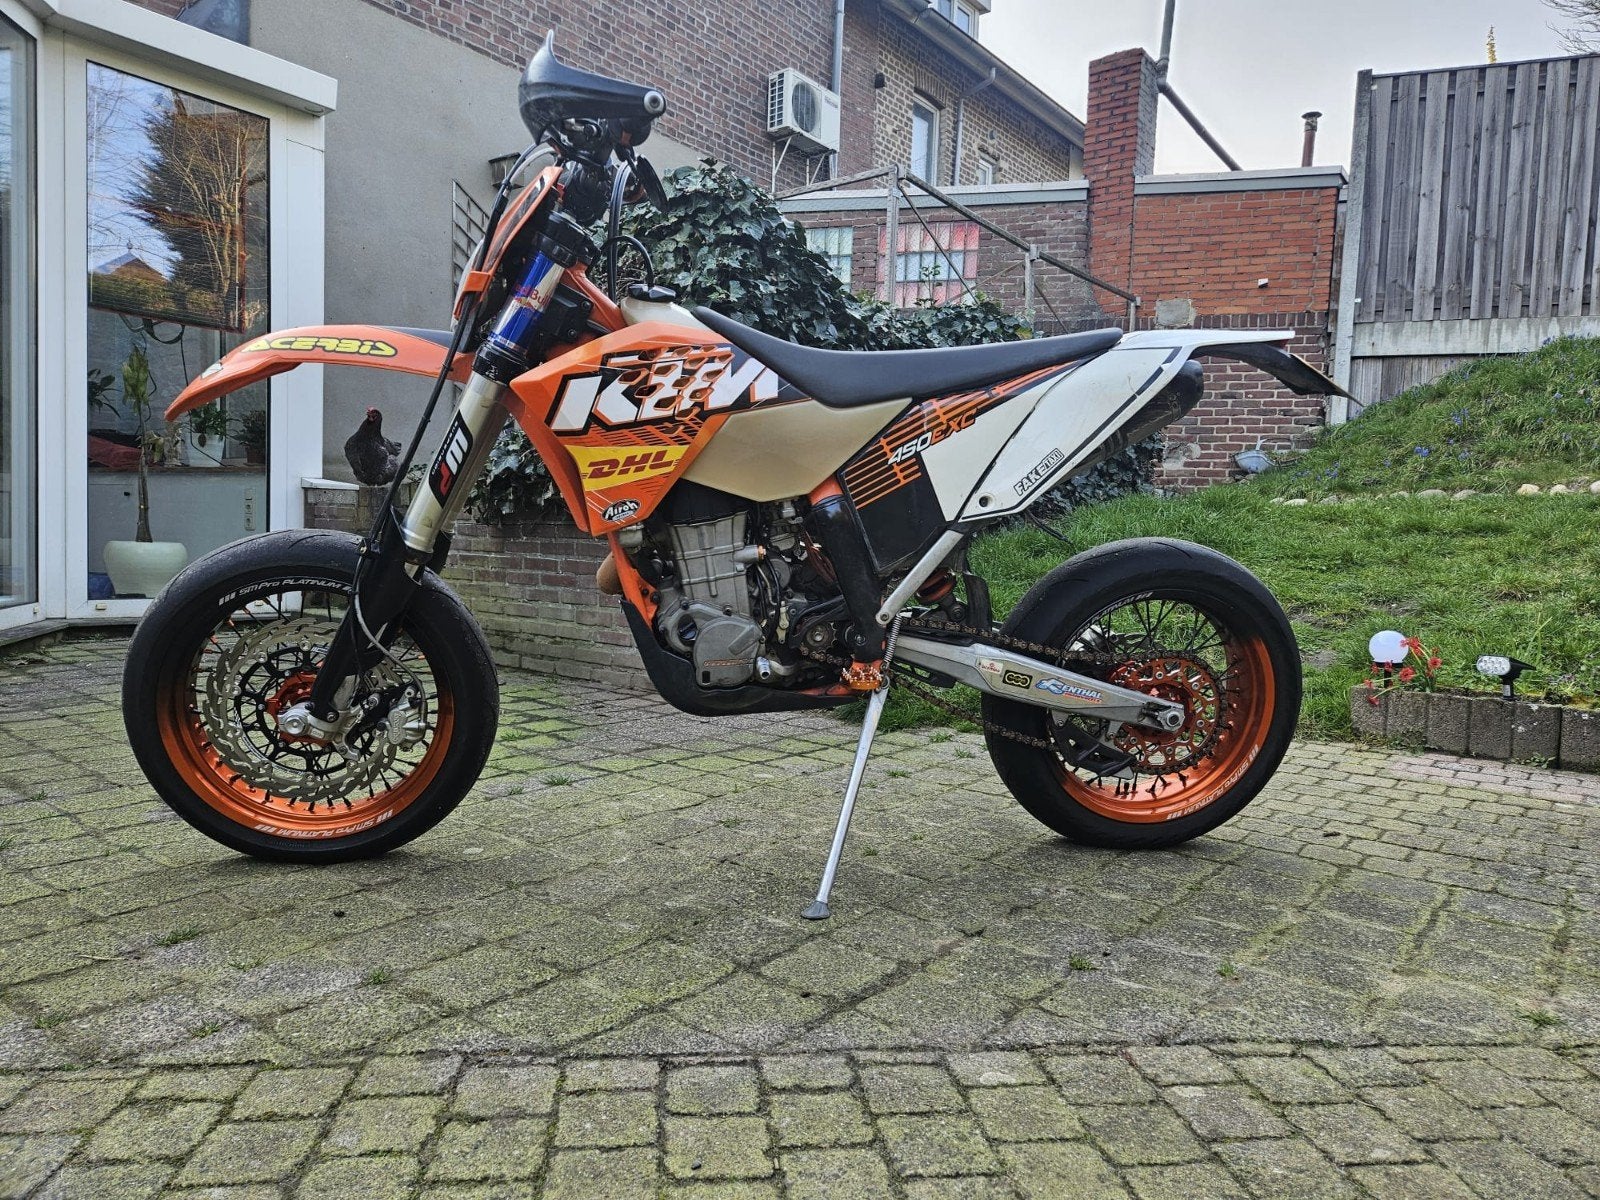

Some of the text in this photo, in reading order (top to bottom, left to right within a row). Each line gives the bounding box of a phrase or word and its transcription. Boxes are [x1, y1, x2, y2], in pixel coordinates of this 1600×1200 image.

[550, 346, 780, 431] KTM
[587, 449, 674, 480] DHL
[604, 501, 639, 520] Airoh
[282, 578, 342, 589] PLATINUM
[276, 828, 335, 838] PLATINUM
